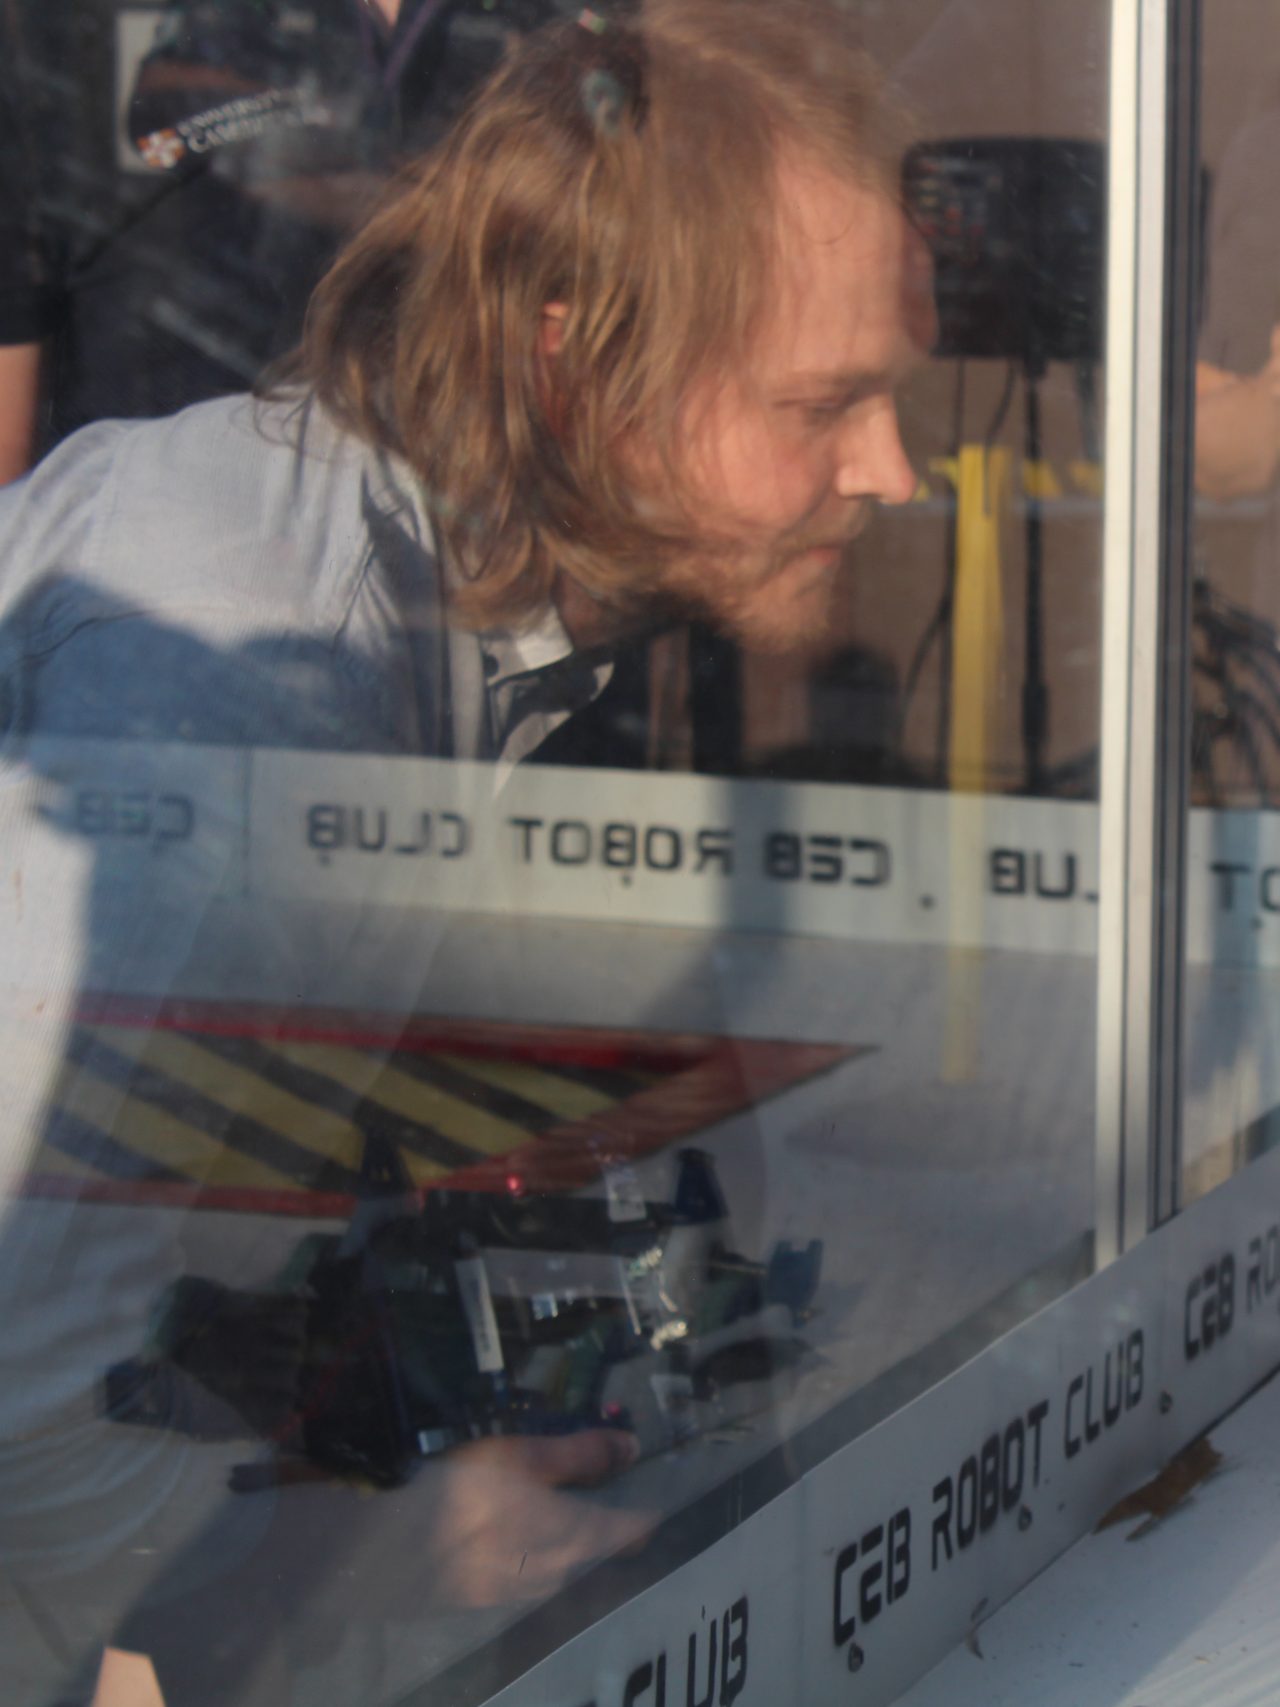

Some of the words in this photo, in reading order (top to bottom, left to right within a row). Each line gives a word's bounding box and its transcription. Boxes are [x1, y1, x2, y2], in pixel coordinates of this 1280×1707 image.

[1185, 1253, 1234, 1361] CEB
[833, 1506, 912, 1647] CEB
[931, 1400, 1049, 1573] ROBOT
[1064, 1328, 1146, 1460] CLUB
